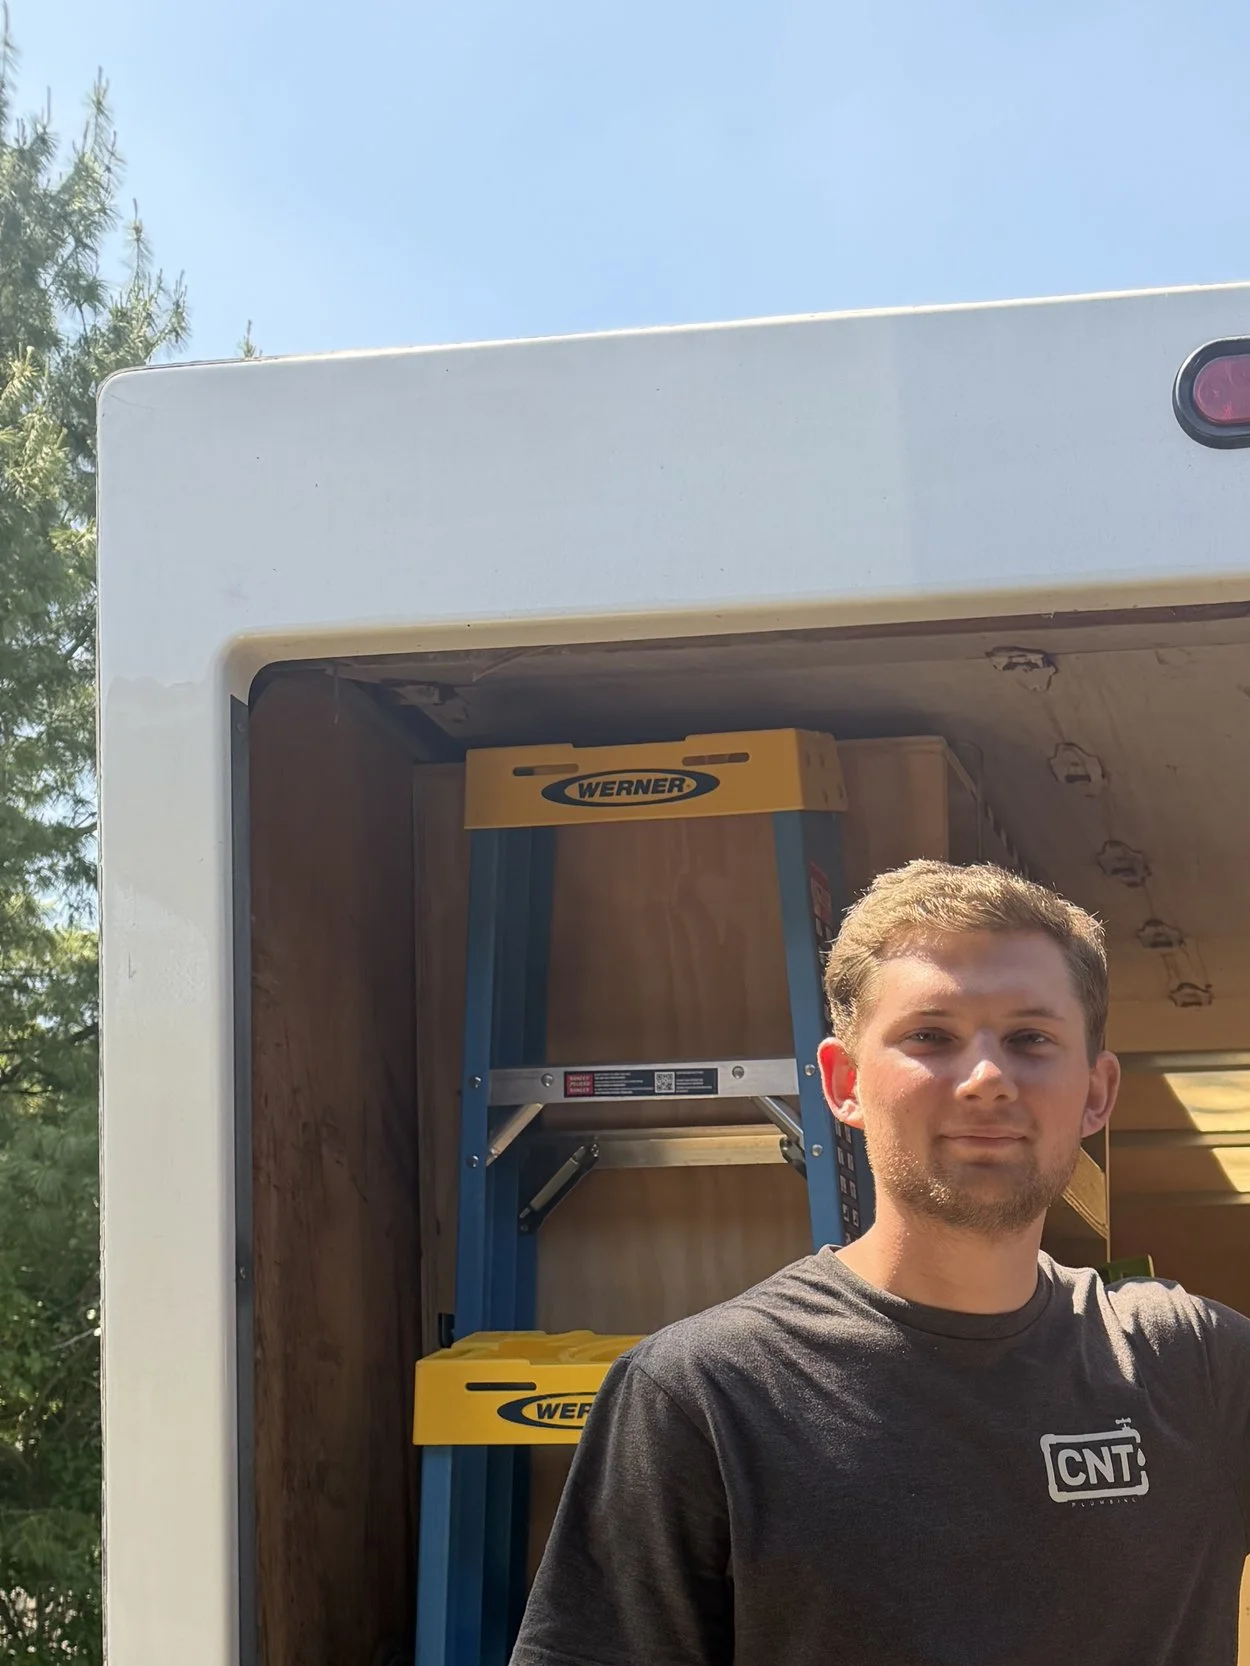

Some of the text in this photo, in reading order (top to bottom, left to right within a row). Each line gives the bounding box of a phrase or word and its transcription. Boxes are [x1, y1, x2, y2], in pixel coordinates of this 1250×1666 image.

[578, 777, 686, 799] WERNER
[536, 1402, 593, 1419] WER
[1057, 1444, 1134, 1486] CNT
